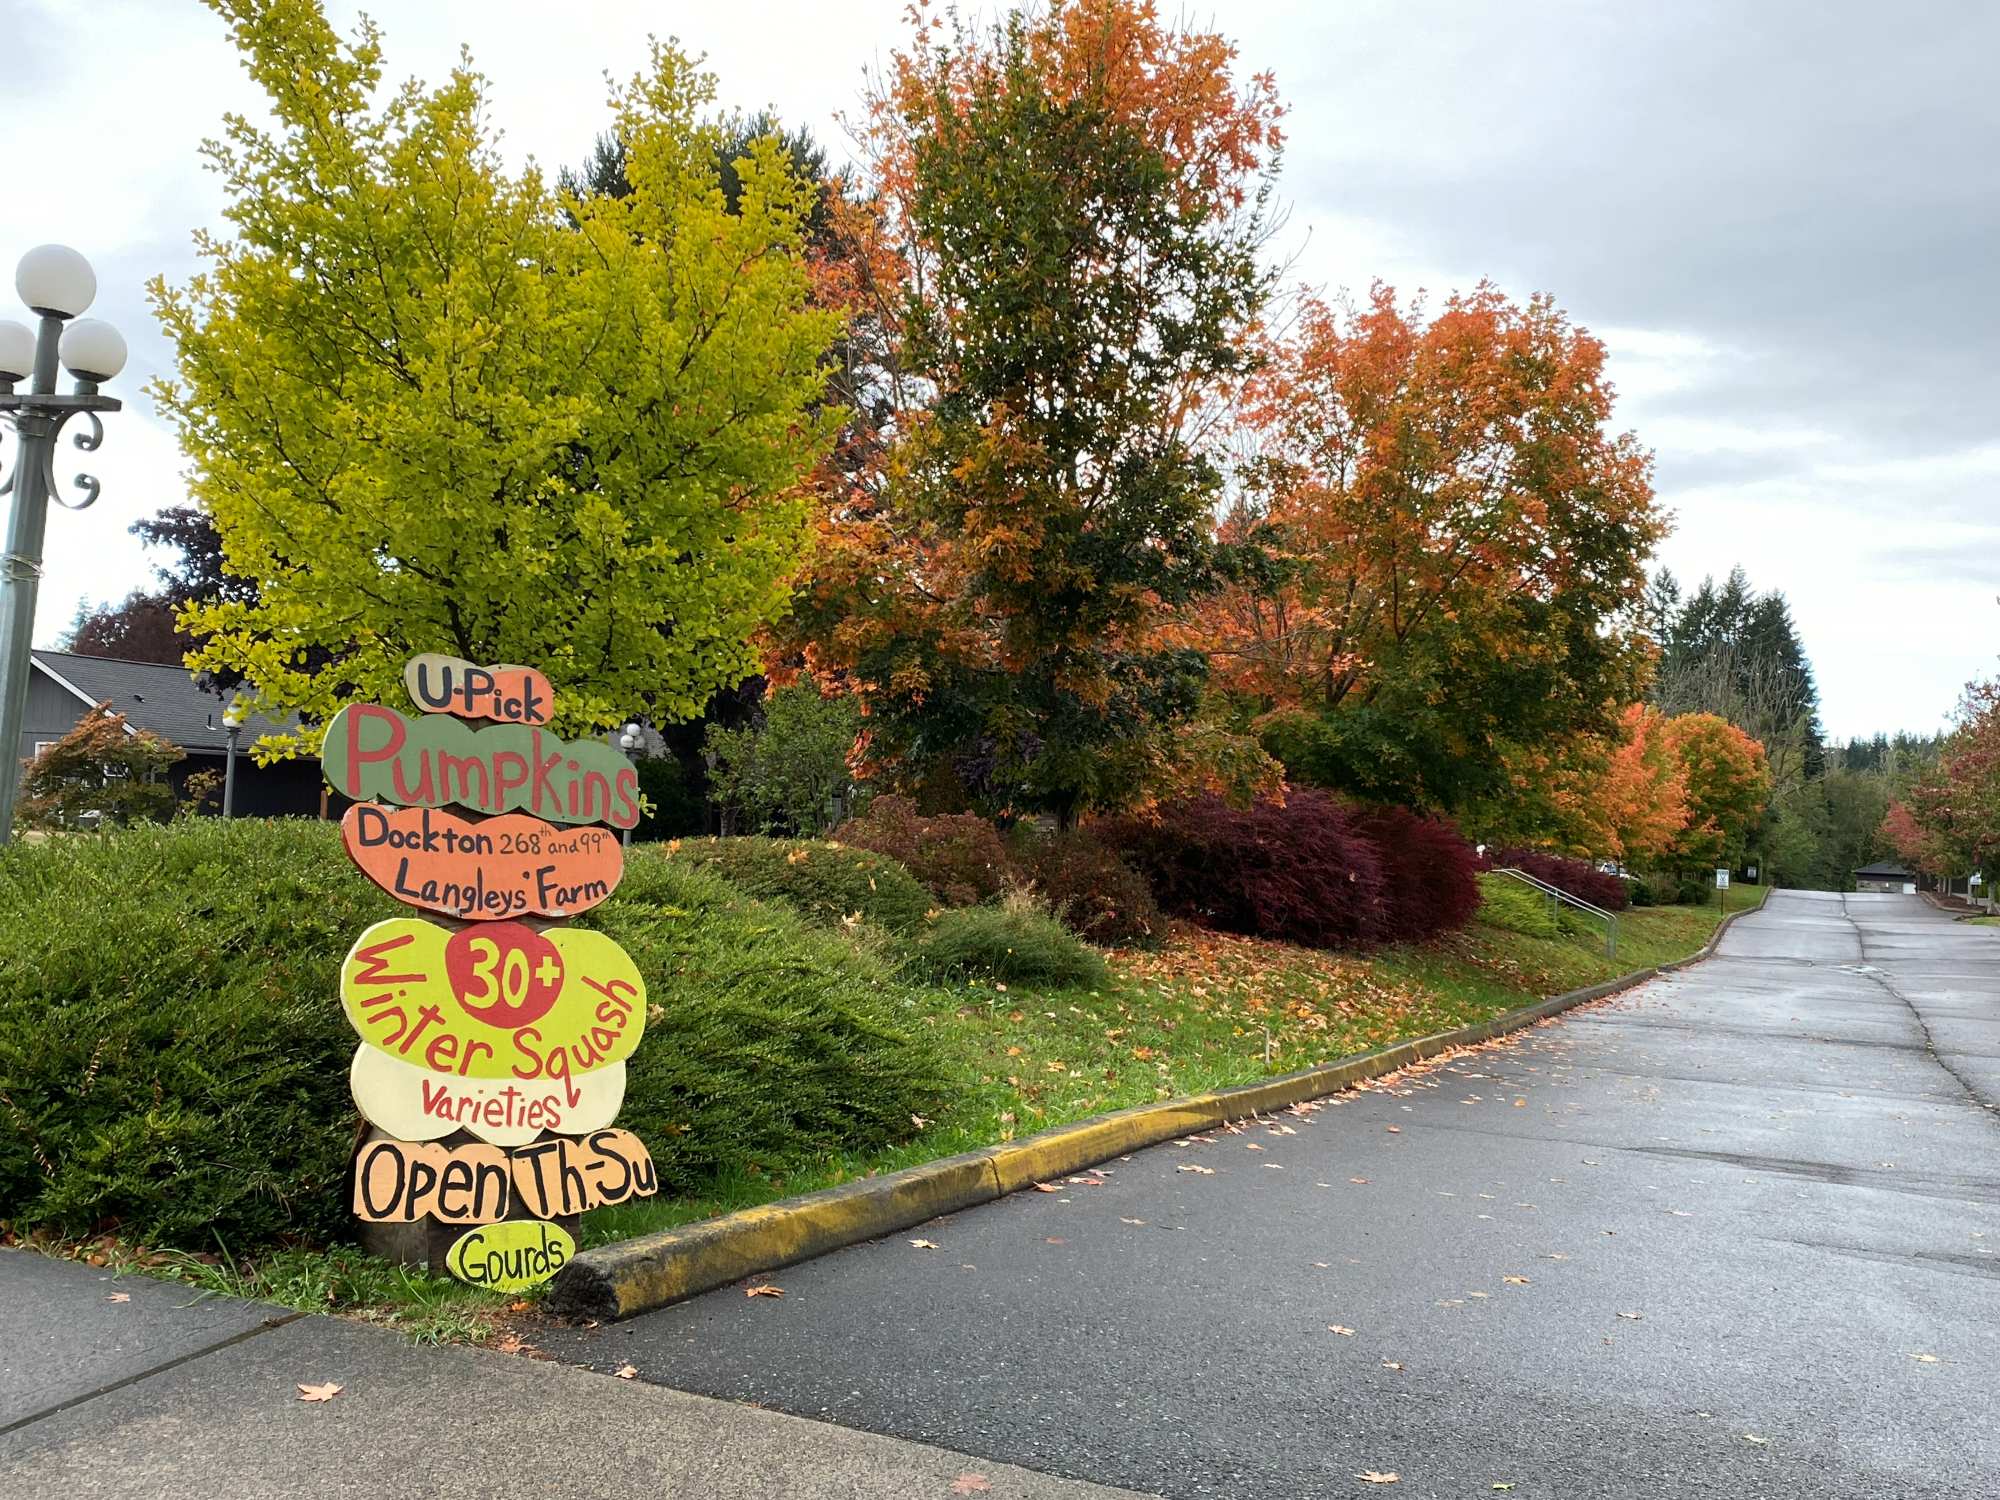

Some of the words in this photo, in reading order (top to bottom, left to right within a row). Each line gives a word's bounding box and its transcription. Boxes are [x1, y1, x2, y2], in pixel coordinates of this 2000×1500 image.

[418, 663, 545, 722] U-Pick
[347, 703, 639, 829] Pumpkins
[358, 807, 494, 854] Dockton
[547, 841, 580, 854] and
[536, 866, 608, 909] Farm
[463, 937, 561, 1009] 30+
[353, 934, 493, 1076] Winter
[511, 975, 638, 1108] Squash
[422, 1079, 561, 1129] Varieties
[361, 1143, 509, 1220] Open
[458, 1225, 564, 1283] Gourds
